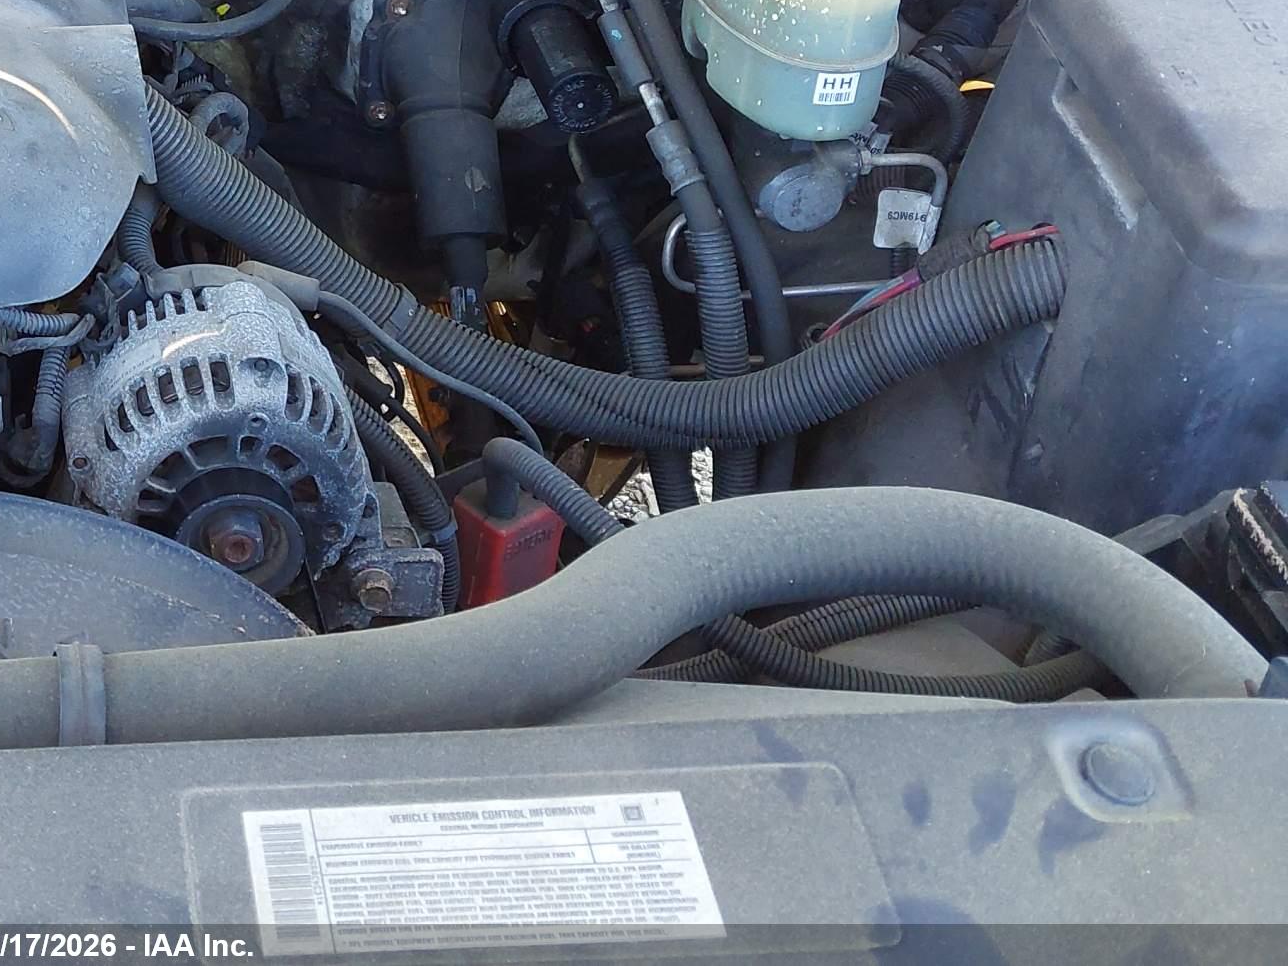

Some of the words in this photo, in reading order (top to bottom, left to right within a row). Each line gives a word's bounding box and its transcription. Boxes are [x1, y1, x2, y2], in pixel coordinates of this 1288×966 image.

[389, 810, 429, 823] VEHICLE
[432, 809, 480, 822] EMISSION
[482, 807, 527, 820] CONTROL
[529, 804, 596, 818] INFORMATION
